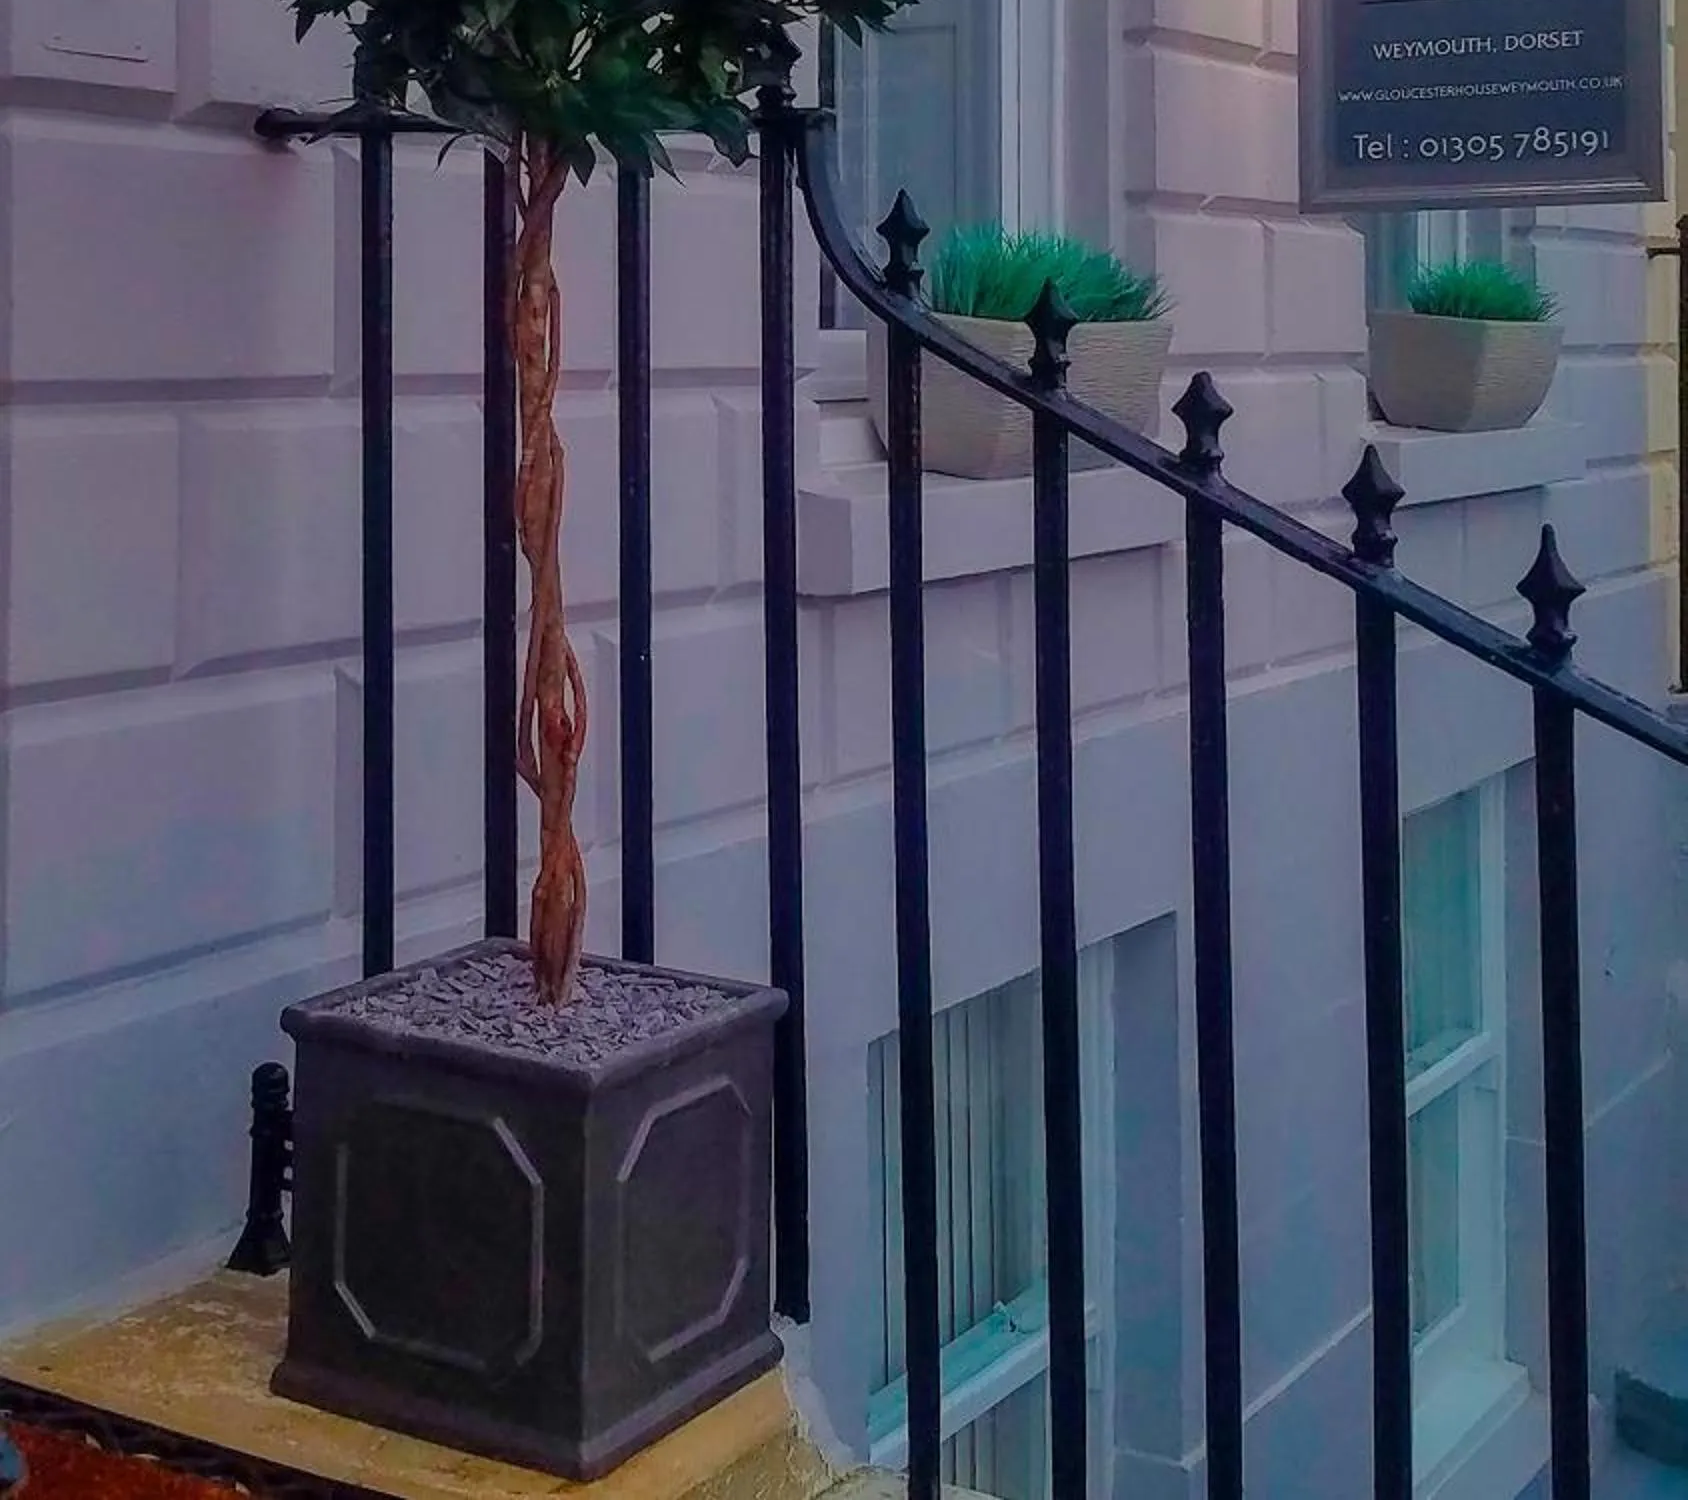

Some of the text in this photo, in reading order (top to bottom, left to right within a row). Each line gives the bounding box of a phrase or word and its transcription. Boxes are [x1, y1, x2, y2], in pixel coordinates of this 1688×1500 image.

[1504, 29, 1585, 51] DORSET
[1338, 75, 1625, 102] WWW.GLOUCESTERHOUSEWEYMOUTH.CO.UK
[1353, 133, 1393, 160] Tel
[1419, 134, 1506, 163] 01305
[1512, 125, 1610, 159] 785191
